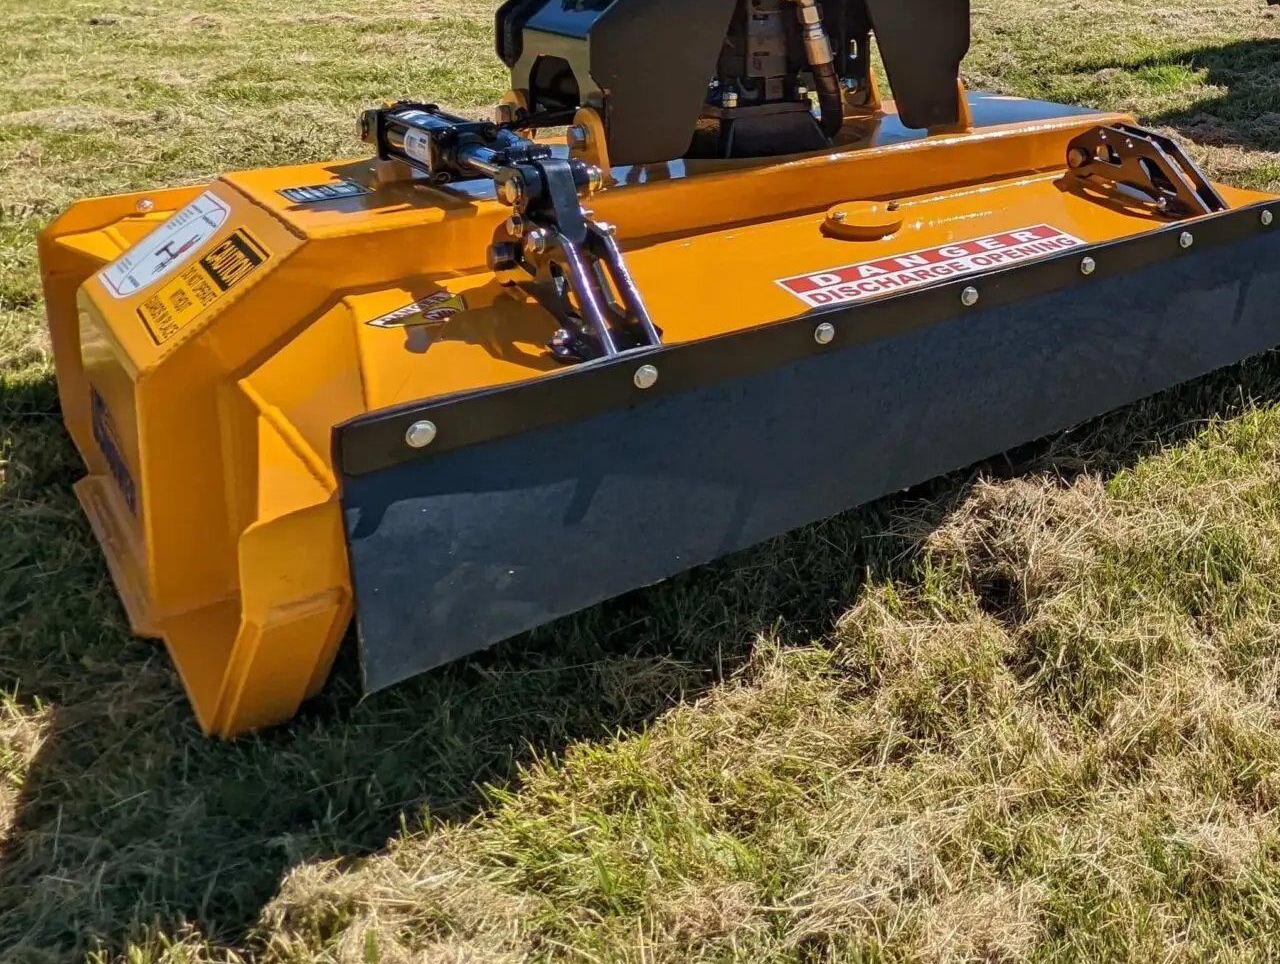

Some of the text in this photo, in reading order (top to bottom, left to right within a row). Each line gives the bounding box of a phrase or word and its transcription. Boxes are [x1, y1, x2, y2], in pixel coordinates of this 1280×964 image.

[203, 238, 255, 287] CAUTION
[806, 229, 1041, 286] DANGER
[808, 236, 1077, 305] DISCHARGE OPENING
